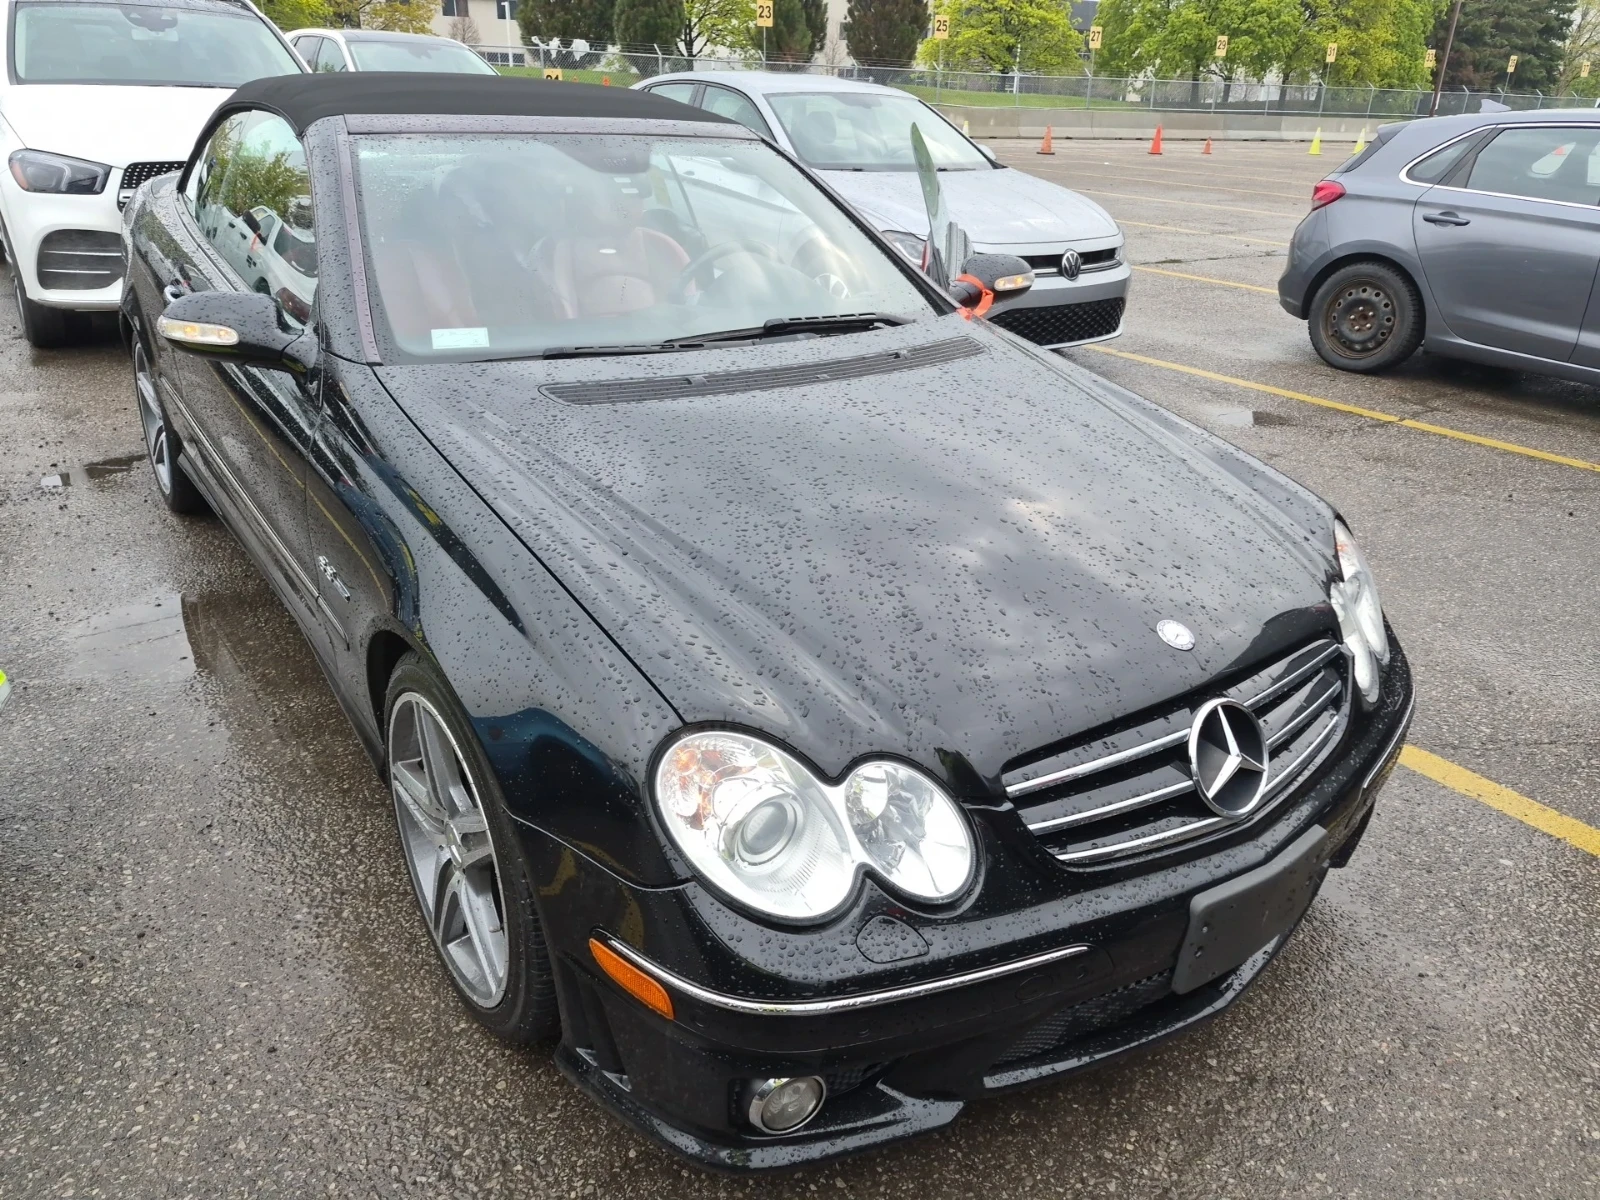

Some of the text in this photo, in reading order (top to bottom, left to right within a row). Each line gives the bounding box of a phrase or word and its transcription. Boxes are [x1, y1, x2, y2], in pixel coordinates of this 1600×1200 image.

[758, 6, 772, 18] 23
[936, 20, 948, 31] 25
[1090, 31, 1101, 41] 27
[1217, 40, 1226, 49] 29
[1328, 47, 1336, 57] 31
[1426, 52, 1434, 62] 33
